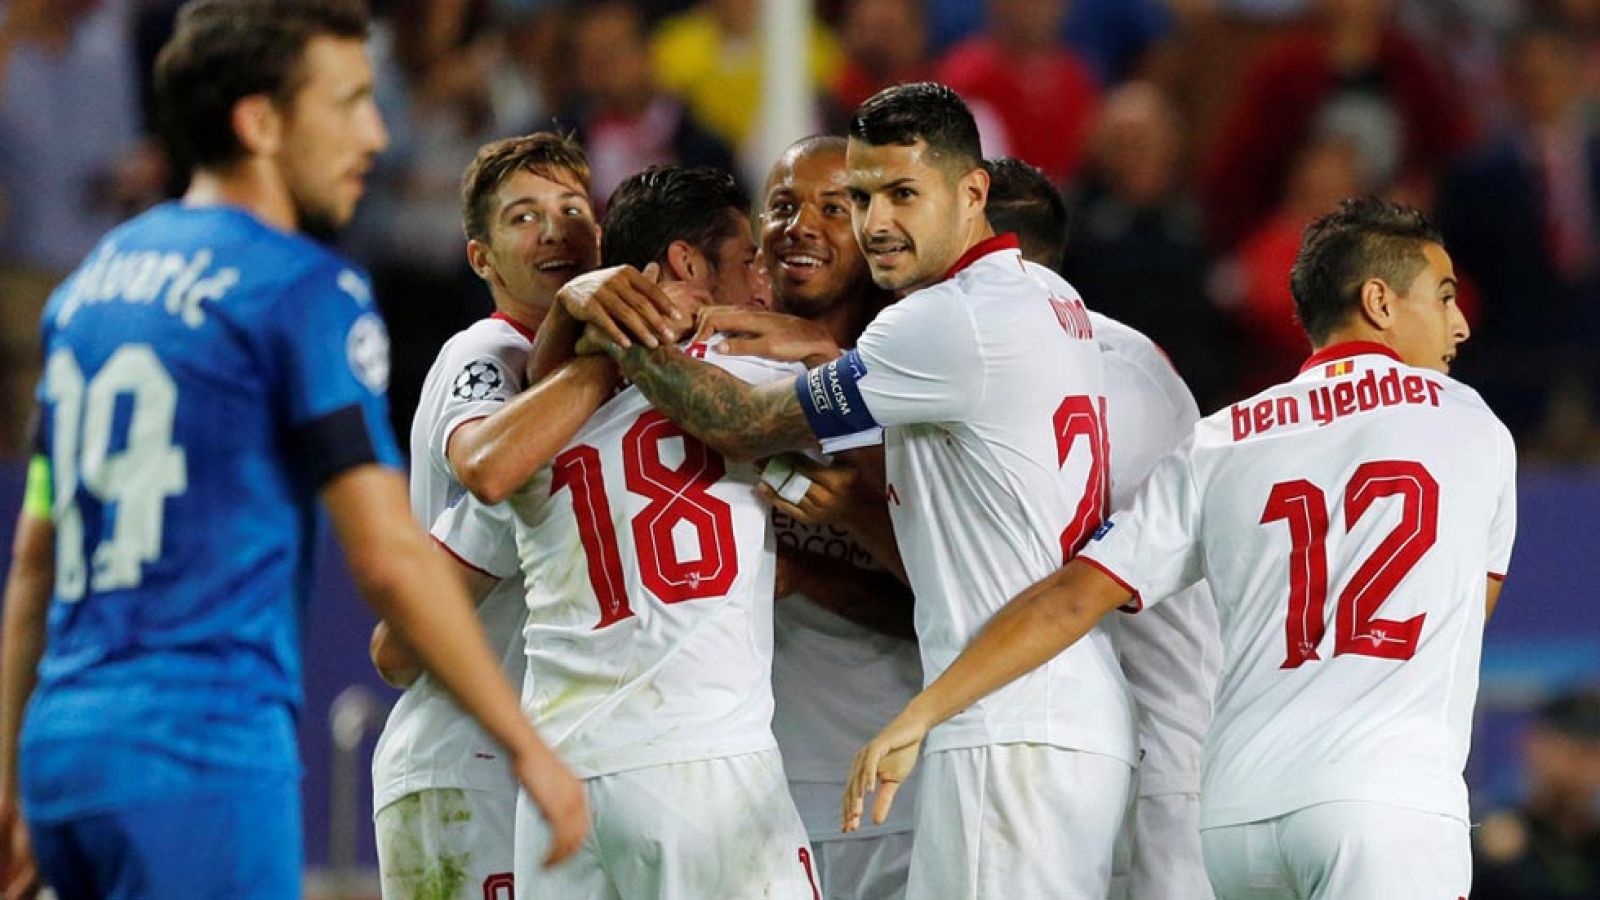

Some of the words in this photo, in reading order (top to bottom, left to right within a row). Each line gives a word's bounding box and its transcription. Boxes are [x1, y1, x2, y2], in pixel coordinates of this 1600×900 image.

[47, 343, 188, 602] 19
[1231, 396, 1299, 441] ben
[1309, 368, 1444, 426] yedder
[550, 409, 738, 630] 18
[1260, 460, 1440, 668] 12
